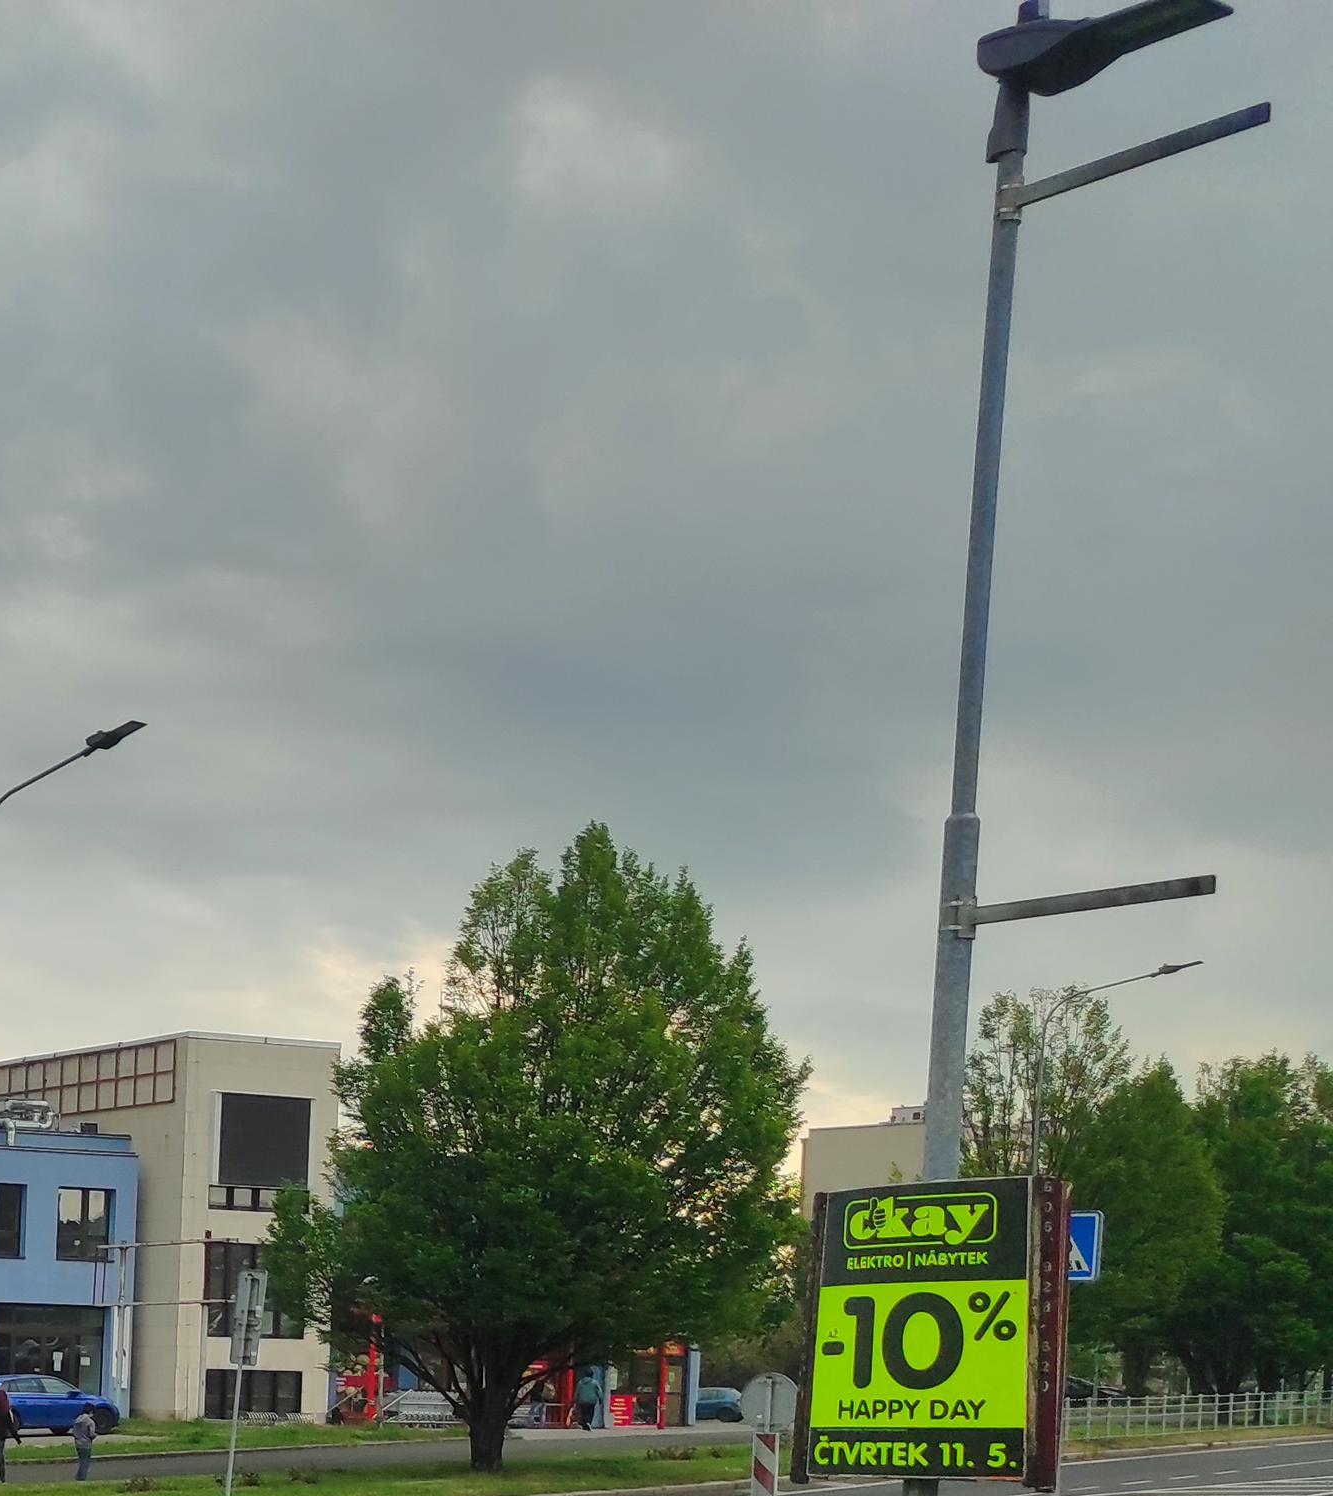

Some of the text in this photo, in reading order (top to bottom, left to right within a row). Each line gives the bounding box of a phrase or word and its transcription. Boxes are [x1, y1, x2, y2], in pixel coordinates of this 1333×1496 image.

[849, 1196, 990, 1246] okay
[846, 1250, 989, 1271] ELEKTRO NÁBYTEK
[827, 1328, 839, 1339] AŽ
[837, 1399, 986, 1420] HAPPY DAY
[813, 1435, 1017, 1468] ČTVRTEK 11. 5.
